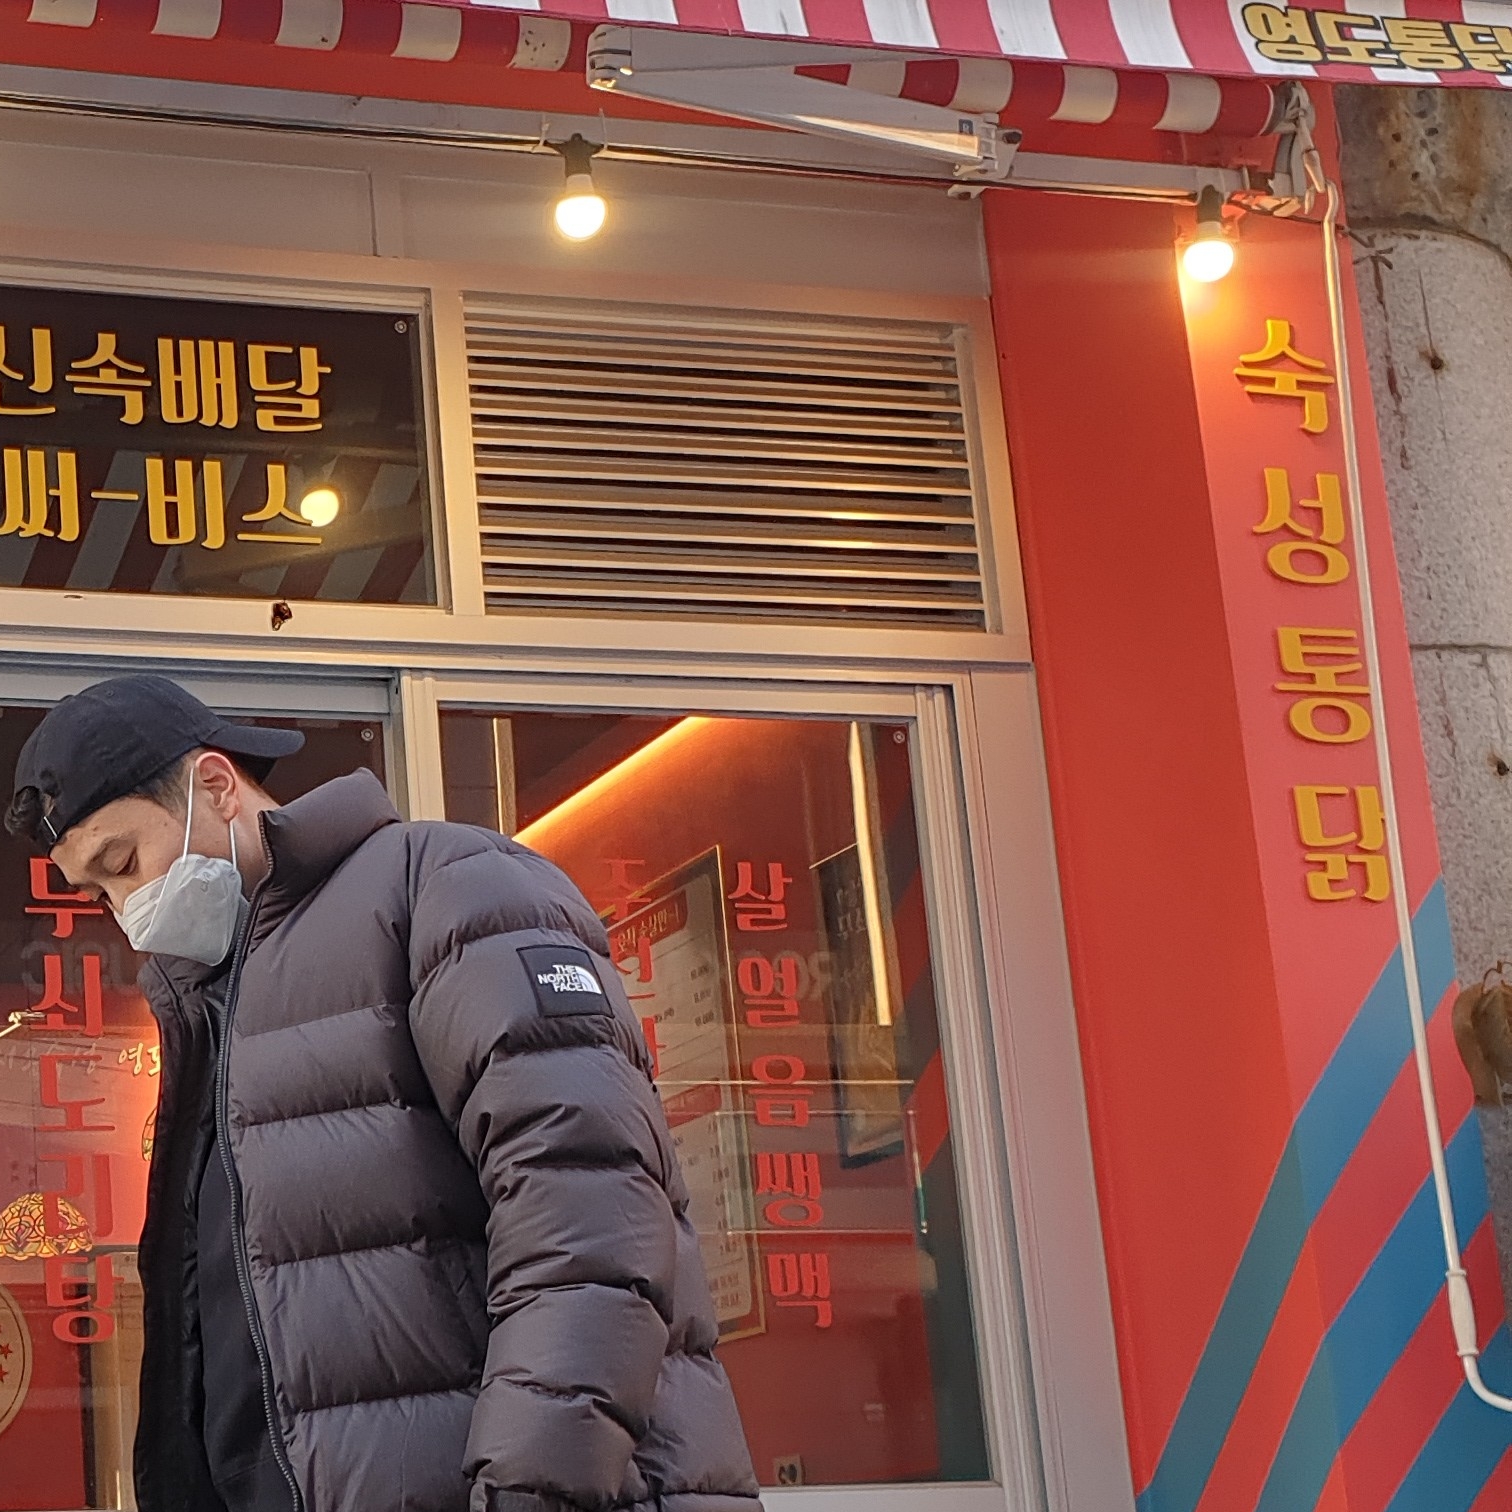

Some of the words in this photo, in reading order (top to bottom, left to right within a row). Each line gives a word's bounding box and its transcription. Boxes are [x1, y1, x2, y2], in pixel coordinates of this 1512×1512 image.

[552, 964, 577, 974] THE
[537, 971, 580, 985] NORTH
[552, 982, 584, 993] FACE
